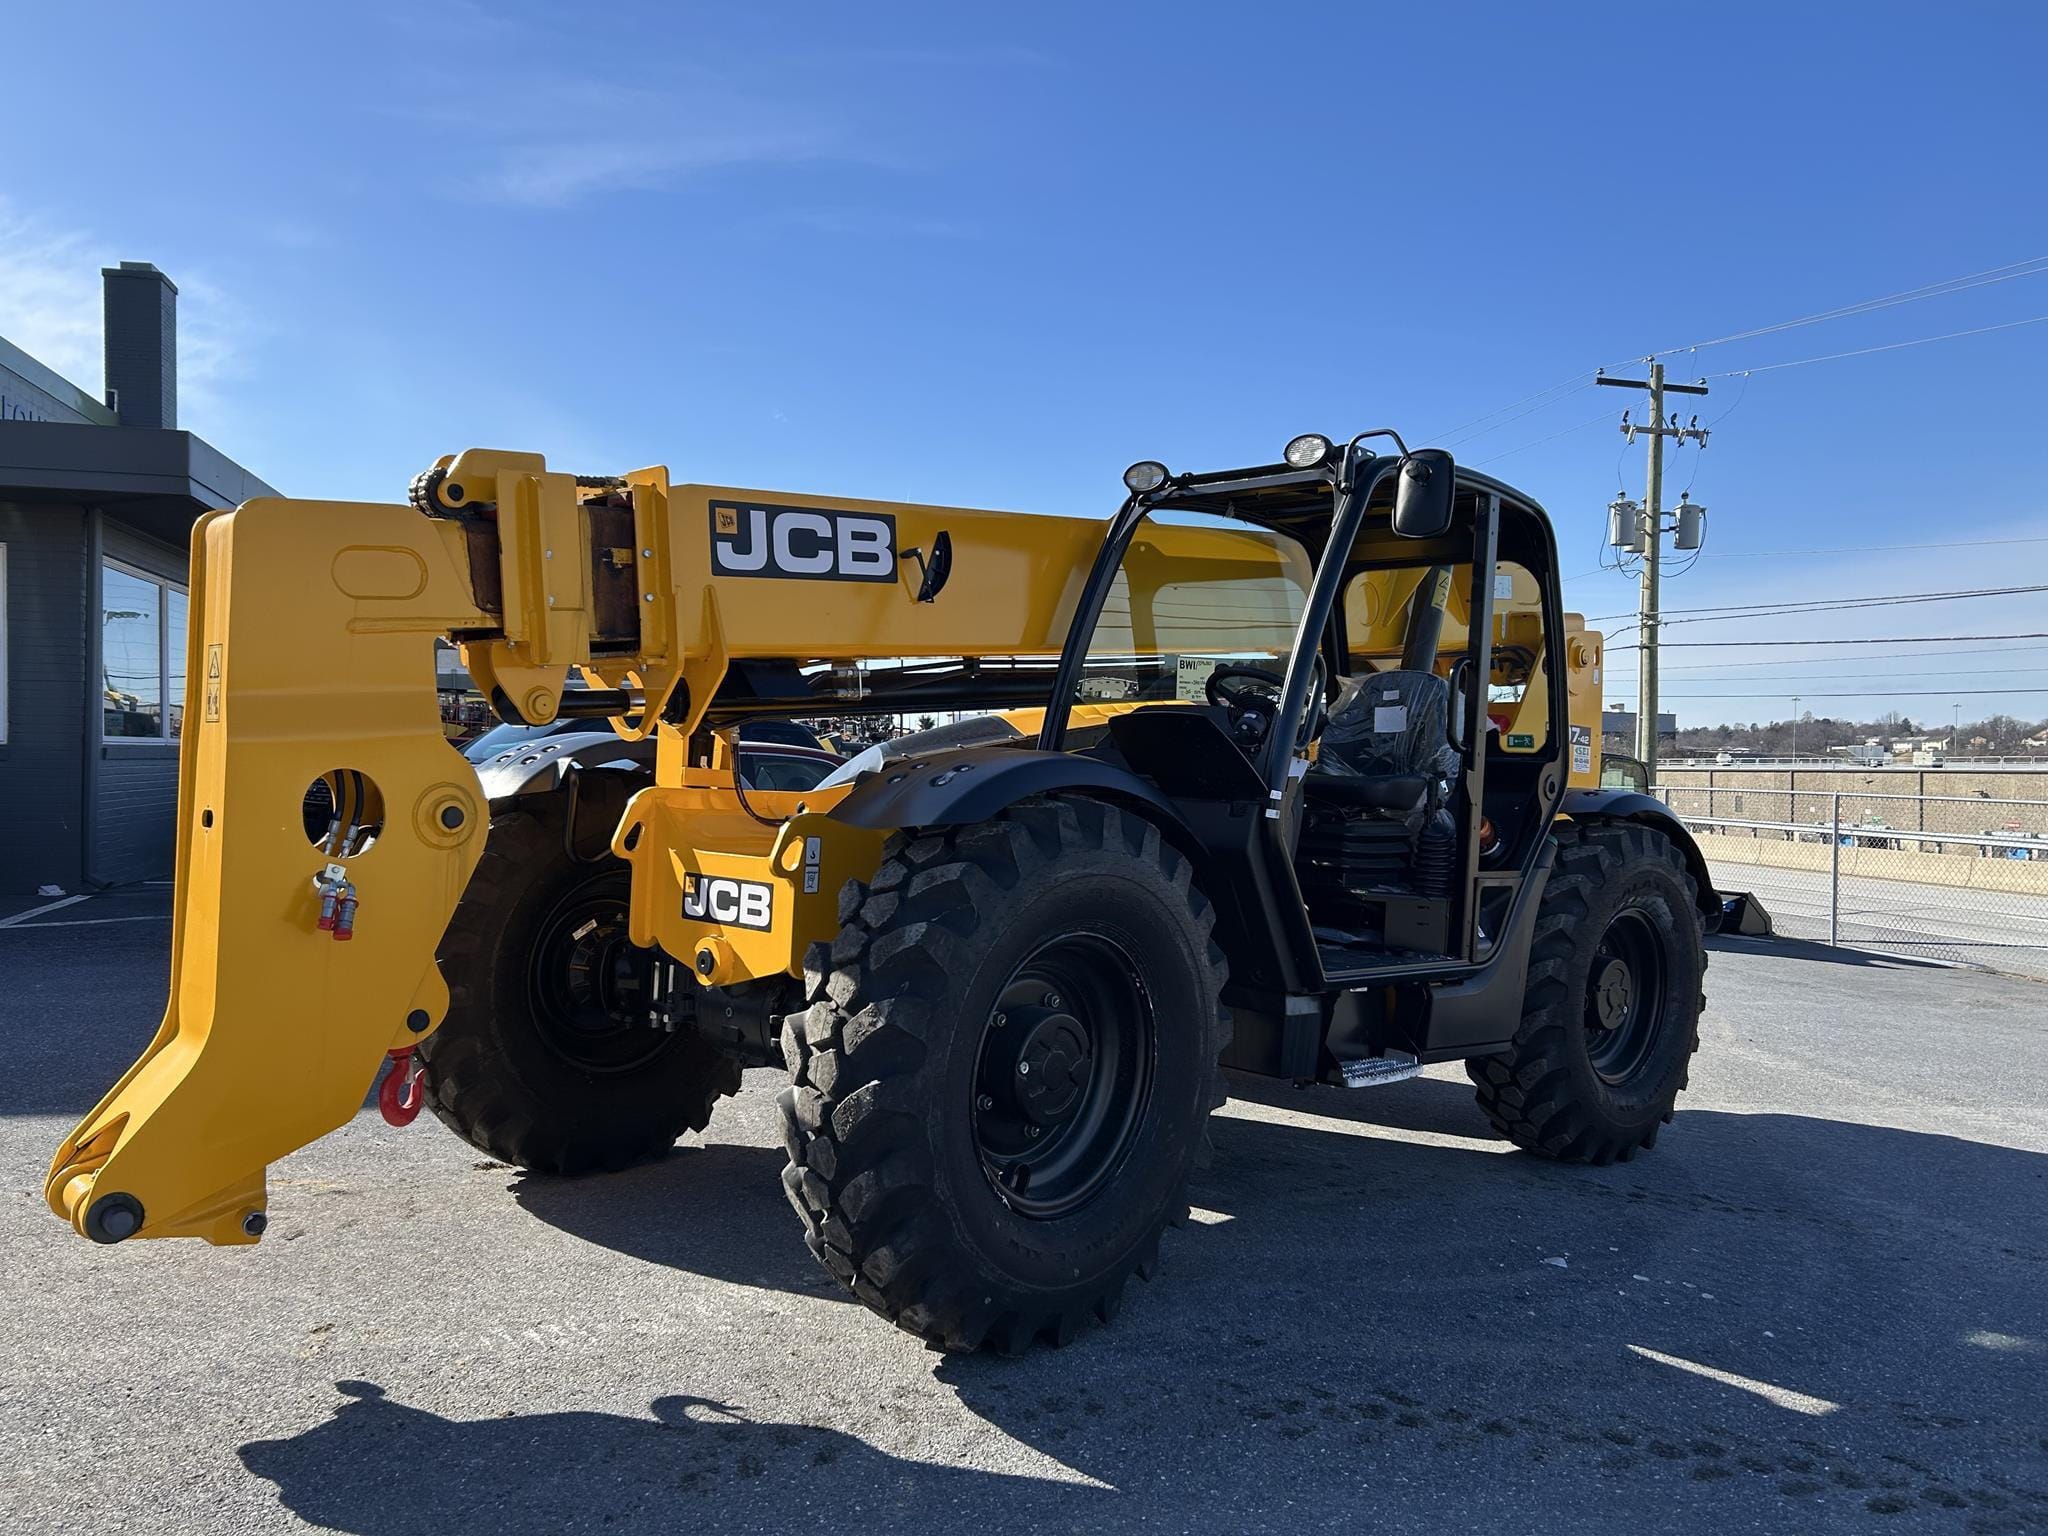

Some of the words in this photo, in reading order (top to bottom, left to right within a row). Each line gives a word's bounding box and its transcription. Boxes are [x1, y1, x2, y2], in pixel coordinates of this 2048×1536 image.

[716, 510, 894, 577] JCB
[1569, 727, 1589, 744] 7-42
[684, 878, 771, 927] JCB
